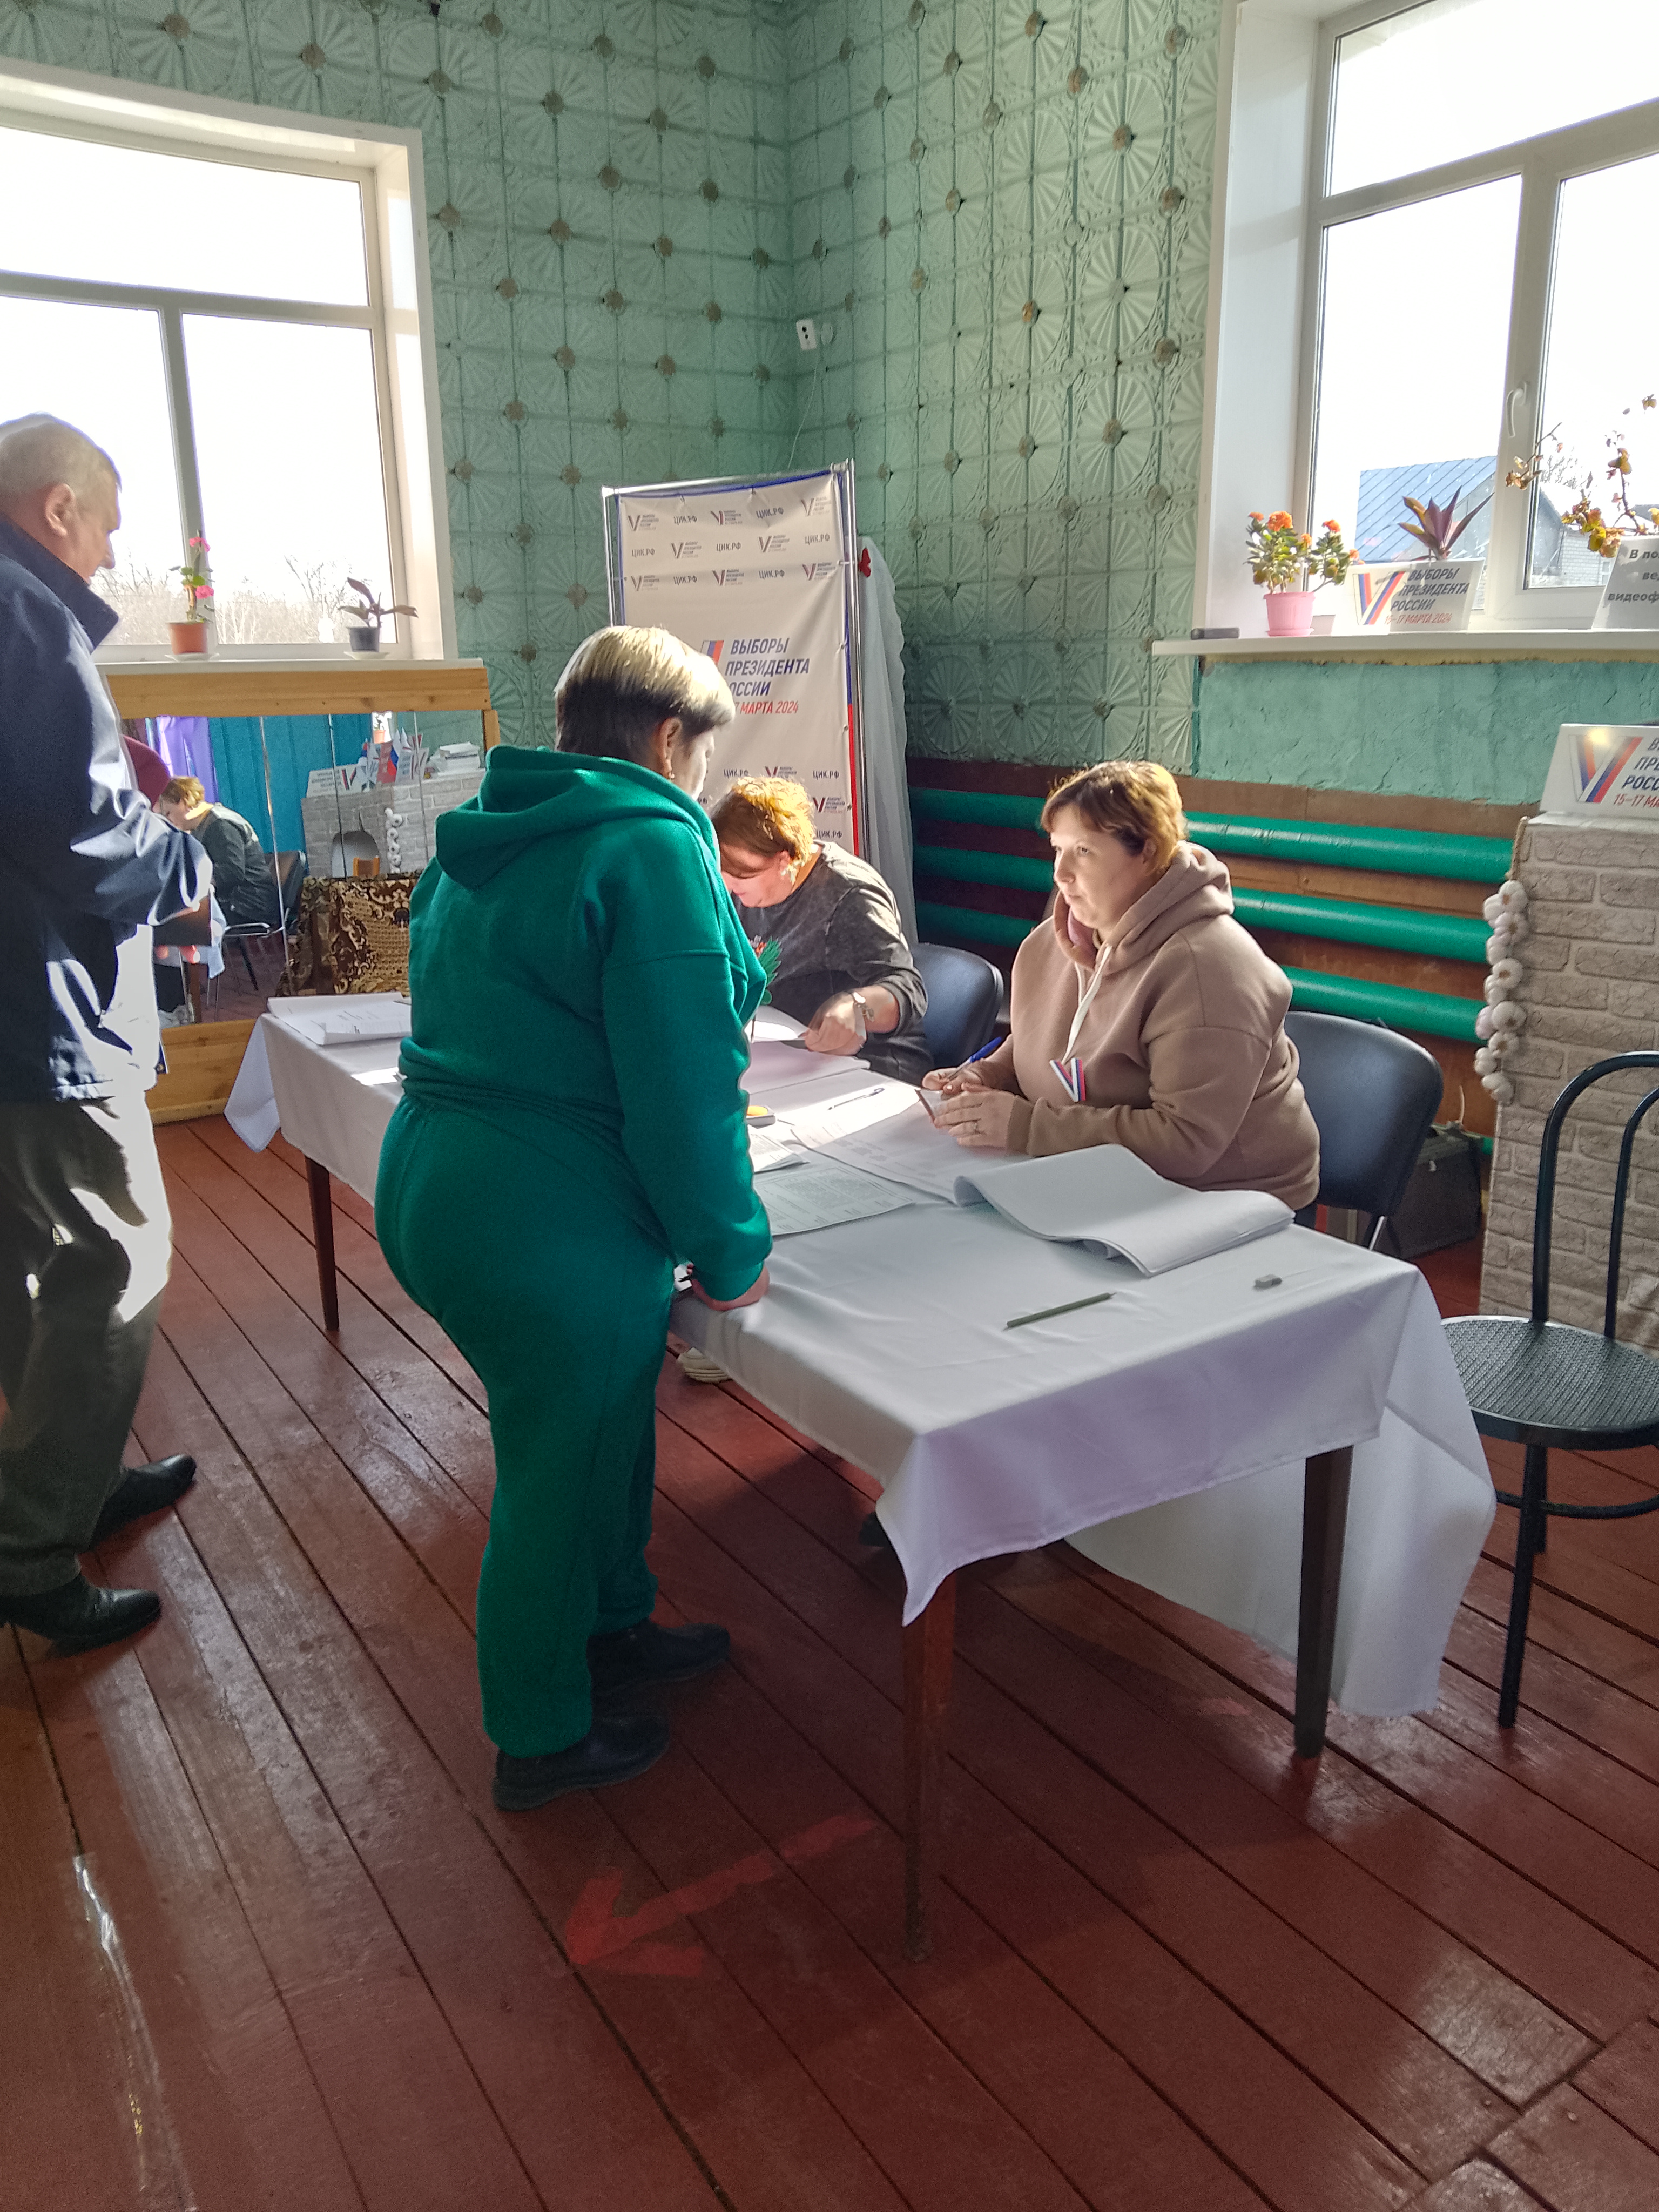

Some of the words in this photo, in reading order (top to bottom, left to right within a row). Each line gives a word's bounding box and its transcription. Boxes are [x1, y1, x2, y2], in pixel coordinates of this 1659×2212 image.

[756, 507, 784, 519] ЦИК.РФ
[674, 515, 697, 525] ЦИК.РФ
[805, 532, 830, 545] ЦИК.РФ
[716, 542, 741, 552] ЦИК.РФ
[631, 548, 655, 558] ЦИК.РФ
[1629, 549, 1639, 559] В
[1642, 551, 1659, 559] по
[759, 570, 785, 581] ЦИК.РФ
[1407, 568, 1460, 581] ВЫБОРЫ
[1642, 572, 1659, 581] ве
[673, 576, 697, 585] ЦИК.РФ
[1398, 583, 1471, 596] ПРЕЗИДЕНТА
[1390, 598, 1436, 611] РОССИИ
[1404, 613, 1433, 624] МАРТА
[1432, 613, 1452, 623] 2024
[730, 637, 790, 655] ВЫБОРЫ
[725, 658, 810, 677] ПРЕЗИДЕНТА
[729, 680, 771, 697] ОССИИ
[740, 701, 773, 714] МАРТА
[775, 700, 799, 714] 2024
[724, 768, 750, 779] ЦИК.РФ
[813, 770, 839, 779] ЦИК.РФ
